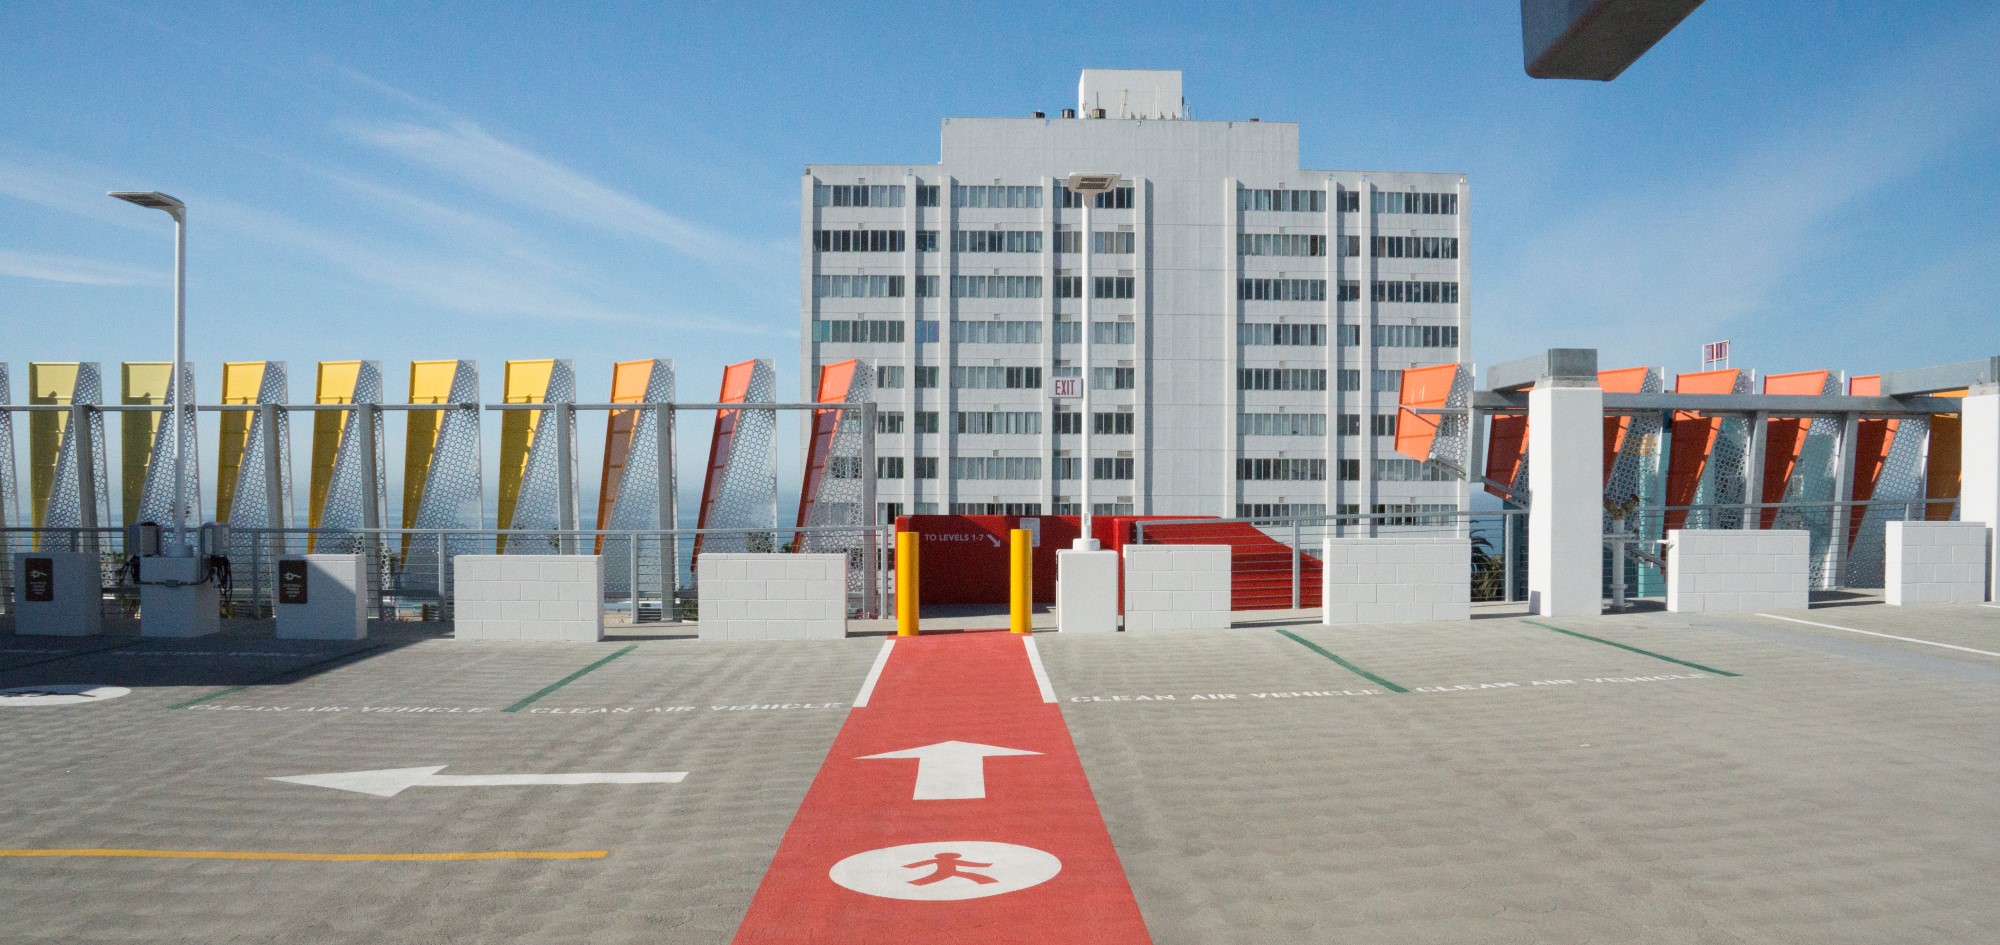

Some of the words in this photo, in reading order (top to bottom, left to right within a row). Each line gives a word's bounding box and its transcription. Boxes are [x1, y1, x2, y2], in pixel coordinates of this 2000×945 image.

[1055, 379, 1075, 395] EXIT
[925, 533, 937, 541] TO
[939, 533, 969, 541] LEVELS
[972, 533, 984, 541] 1-7
[1416, 681, 1519, 692] CLEAN
[1071, 694, 1176, 702] CLEAN
[1250, 689, 1383, 698] VEHICLE
[711, 702, 843, 711] VEHICLE
